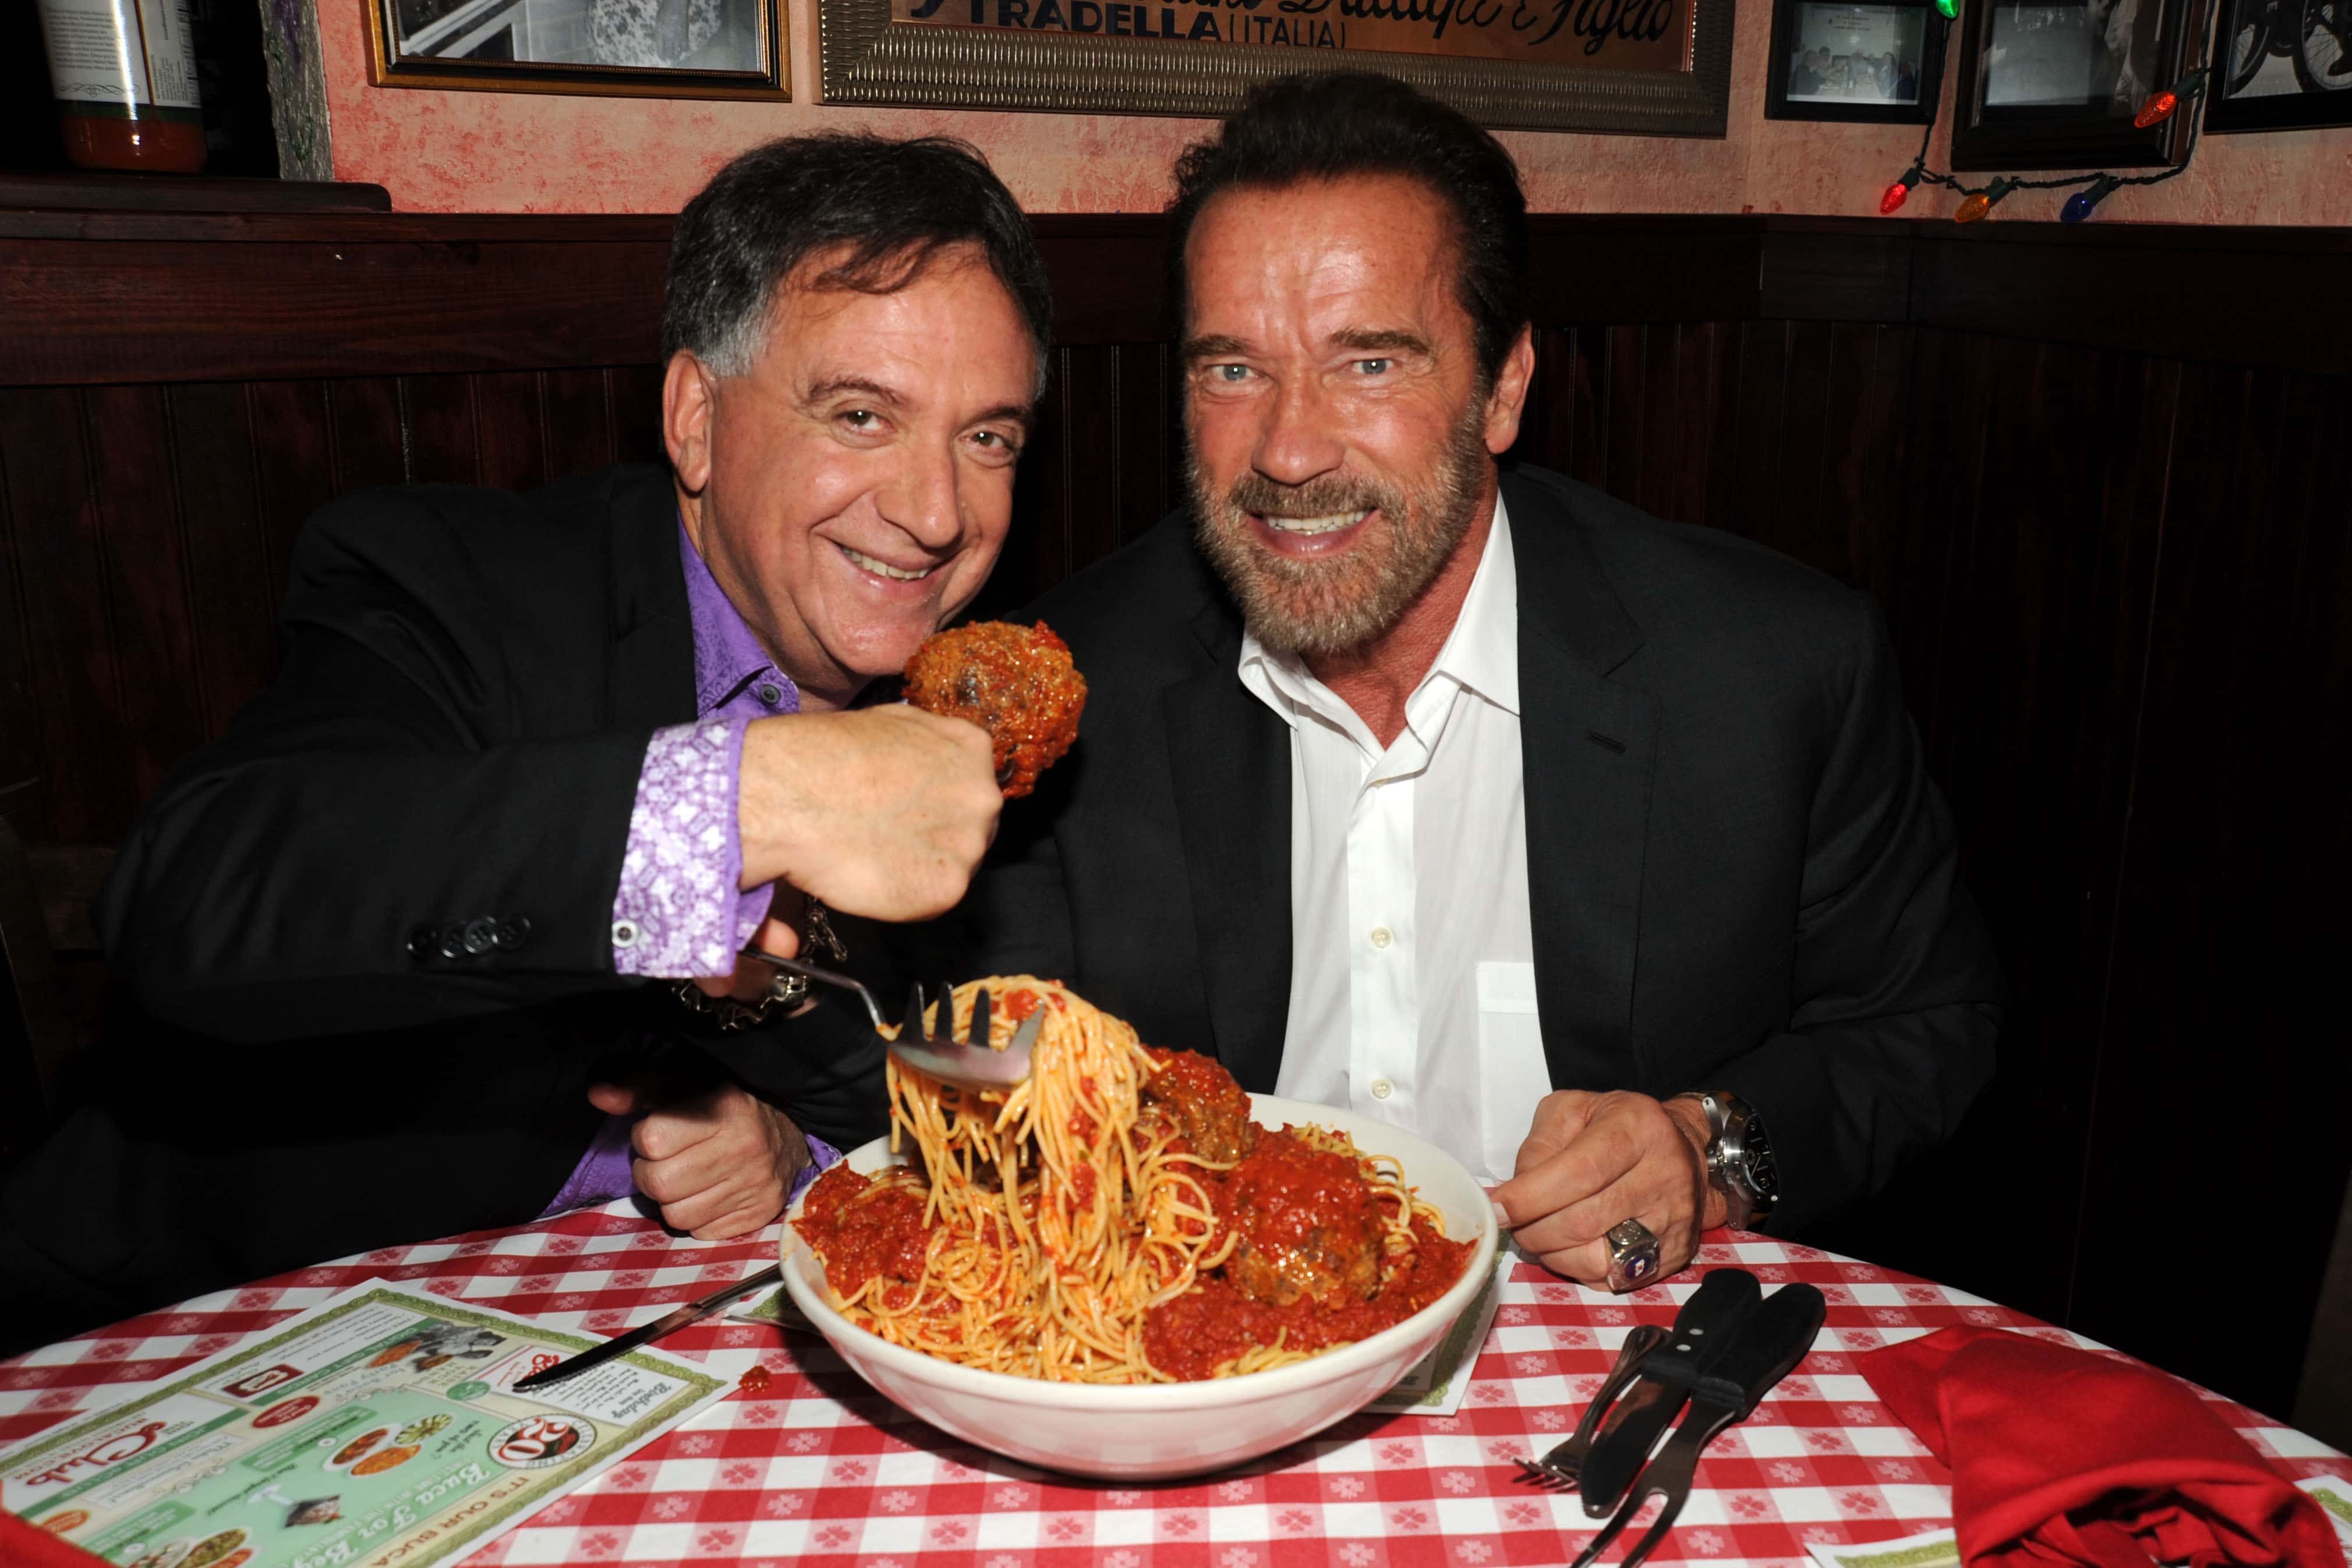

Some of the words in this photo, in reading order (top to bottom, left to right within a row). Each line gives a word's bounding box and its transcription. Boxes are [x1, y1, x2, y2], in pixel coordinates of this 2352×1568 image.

[910, 0, 1222, 42] TRADELLA
[610, 1383, 672, 1420] Birthday
[497, 1417, 570, 1461] 20
[415, 1462, 490, 1509] Buca
[489, 1476, 530, 1499] IT'S
[357, 1505, 418, 1539] For
[440, 1499, 489, 1529] OUR
[370, 1529, 438, 1567] BUCA
